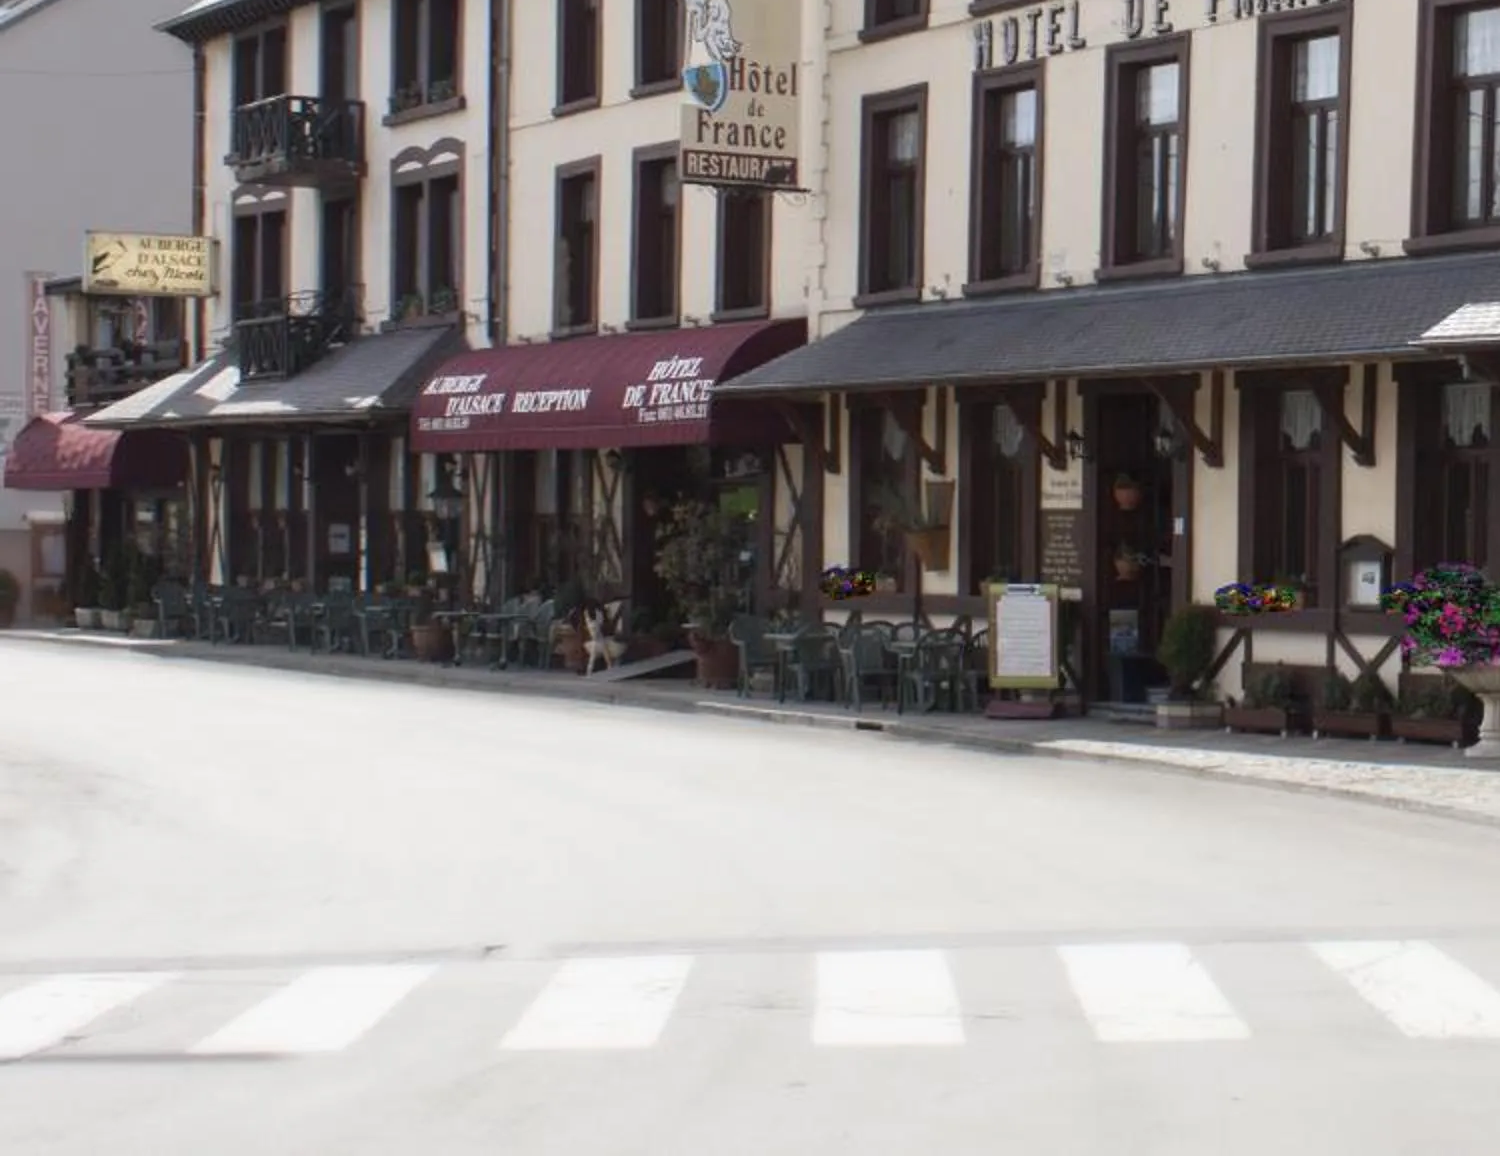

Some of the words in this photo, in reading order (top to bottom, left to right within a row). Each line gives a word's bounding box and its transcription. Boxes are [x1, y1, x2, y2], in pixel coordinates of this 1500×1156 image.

[729, 56, 797, 96] Hôtel
[747, 97, 765, 117] de
[697, 107, 787, 150] France
[687, 152, 794, 184] RESTAURA
[32, 277, 49, 414] TAVERNE
[622, 384, 647, 409] DE
[648, 379, 715, 406] FRANCE
